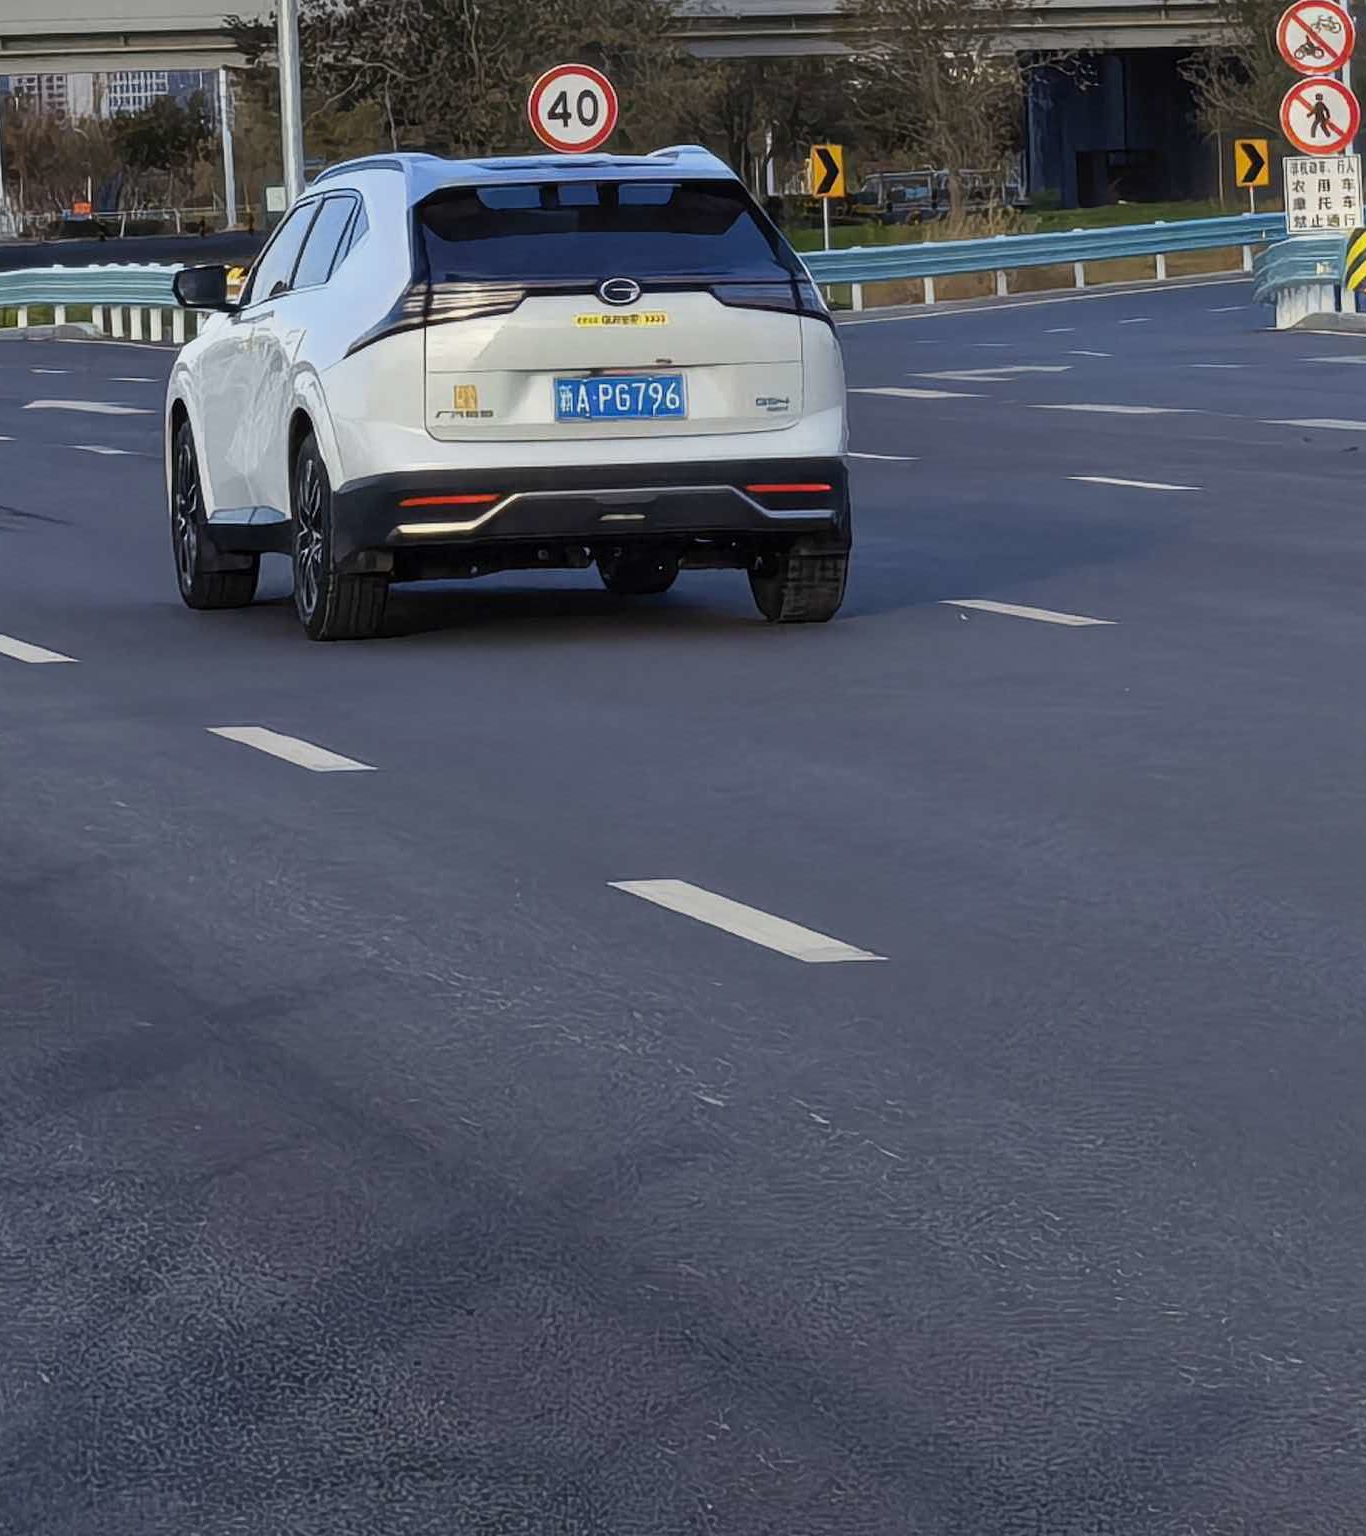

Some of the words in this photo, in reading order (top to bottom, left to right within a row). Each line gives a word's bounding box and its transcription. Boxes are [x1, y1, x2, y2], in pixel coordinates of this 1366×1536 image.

[547, 89, 599, 128] 40
[1293, 214, 1356, 228] 禁止通行
